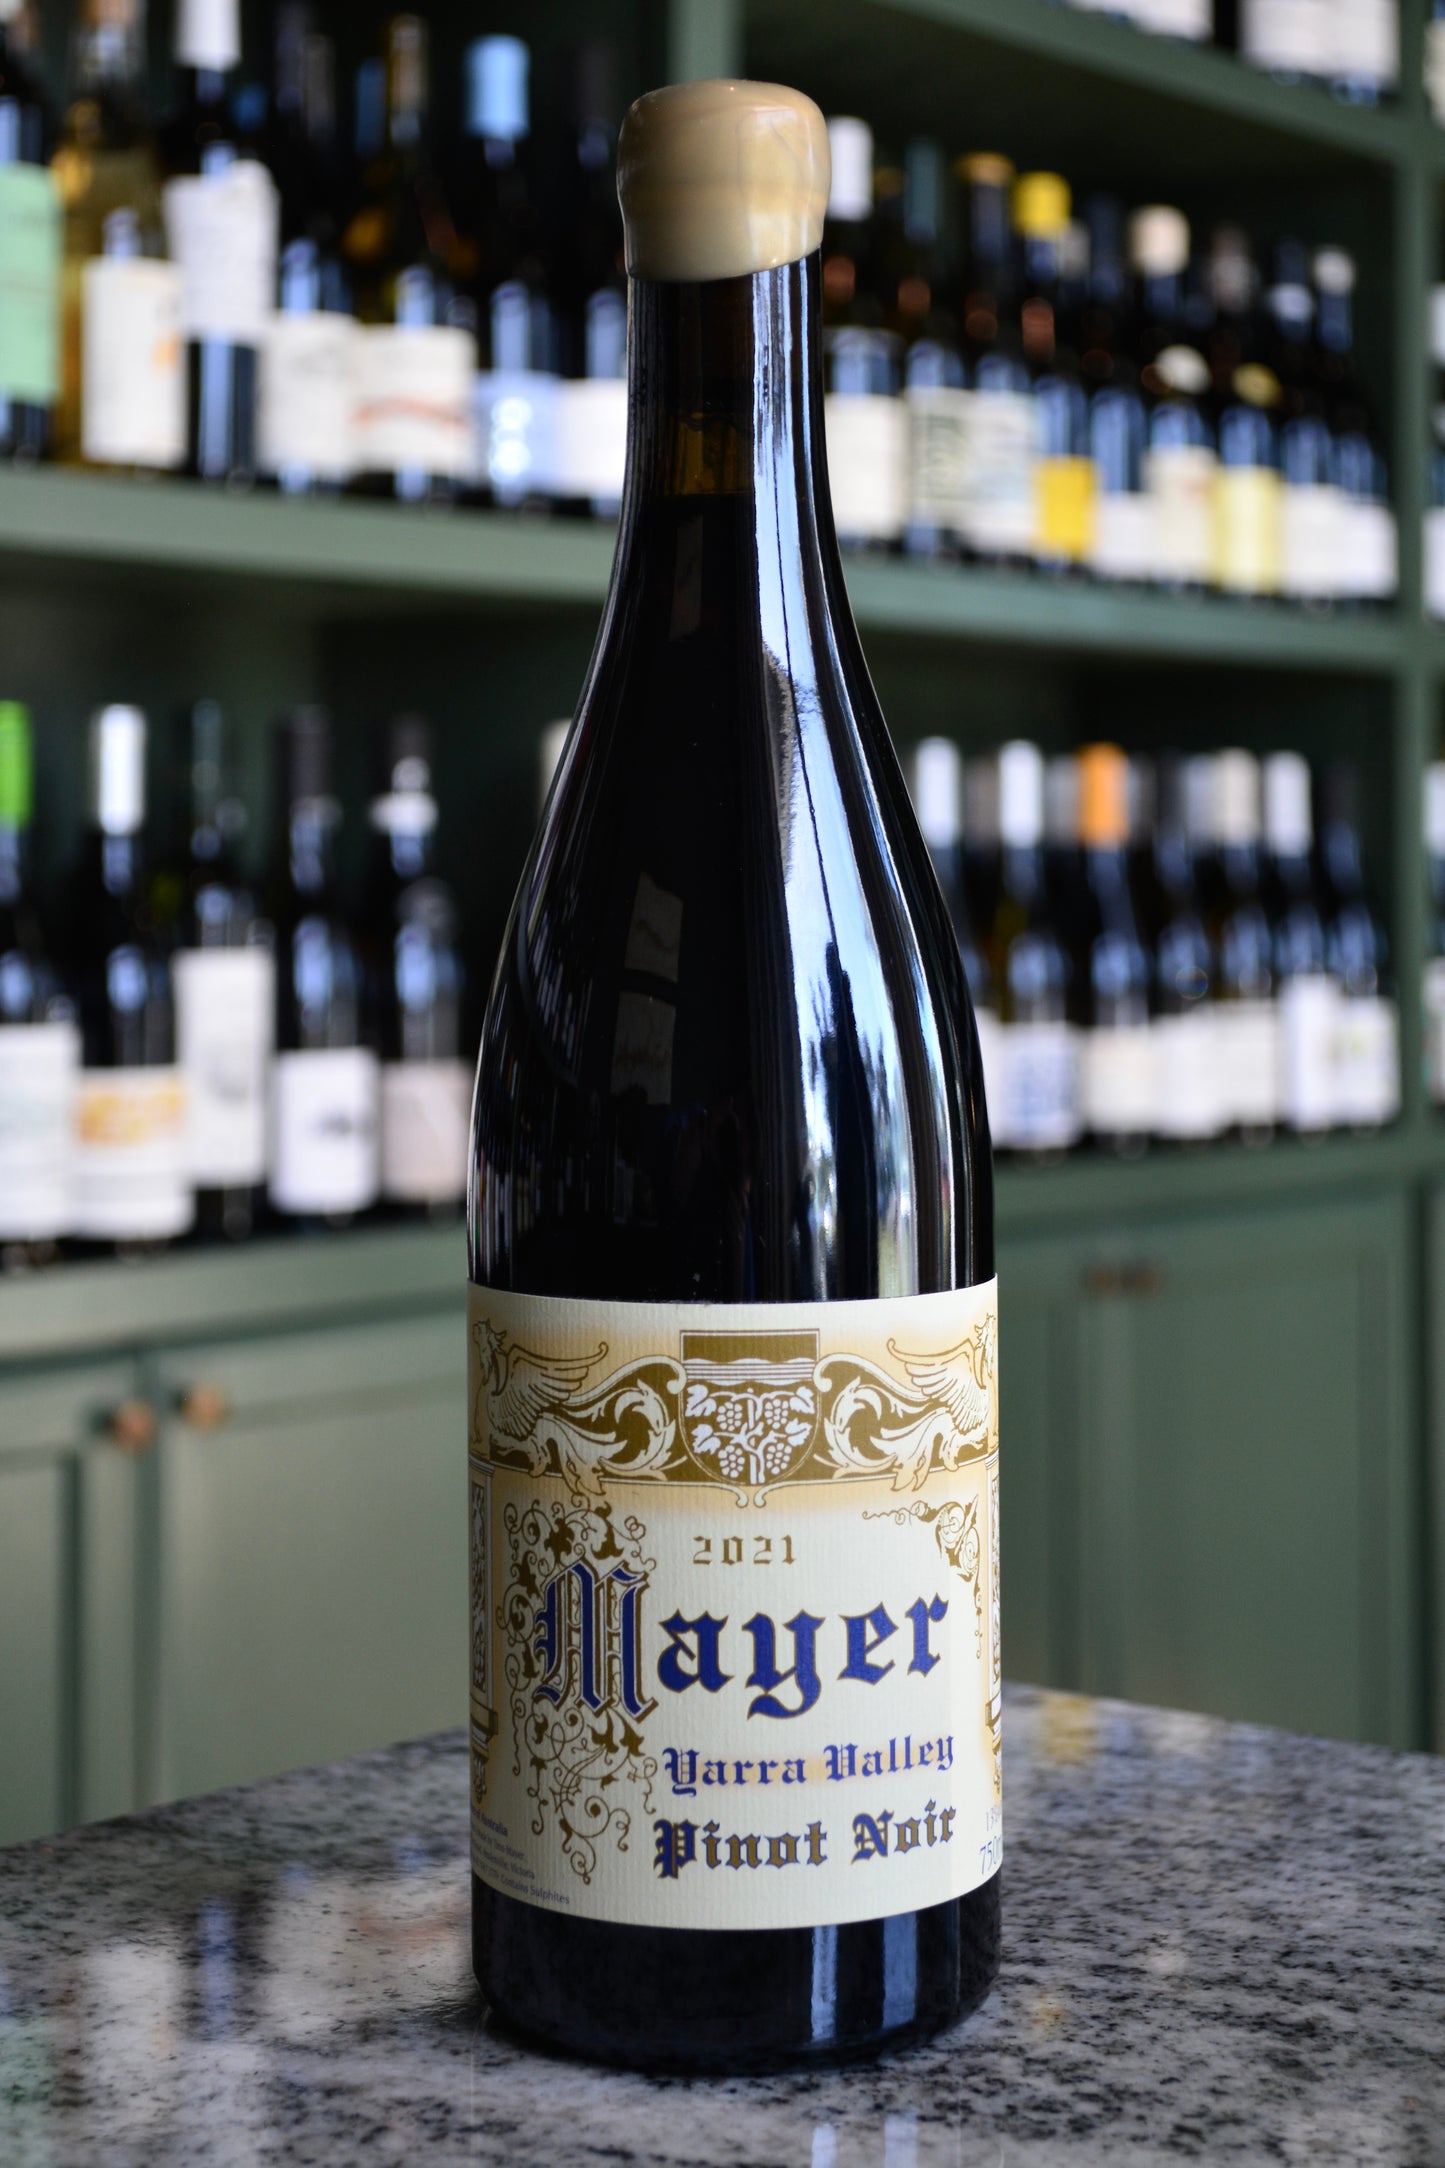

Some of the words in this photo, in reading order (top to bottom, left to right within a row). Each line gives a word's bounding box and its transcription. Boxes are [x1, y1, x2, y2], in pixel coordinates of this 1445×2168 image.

[692, 1535, 796, 1566] 2021
[533, 1557, 948, 1723] Mayer
[662, 1747, 807, 1798] Yarra
[822, 1735, 955, 1783] Valley
[653, 1819, 829, 1880] Pinot
[852, 1799, 956, 1865] Noir
[529, 1887, 570, 1905] Sulphites
